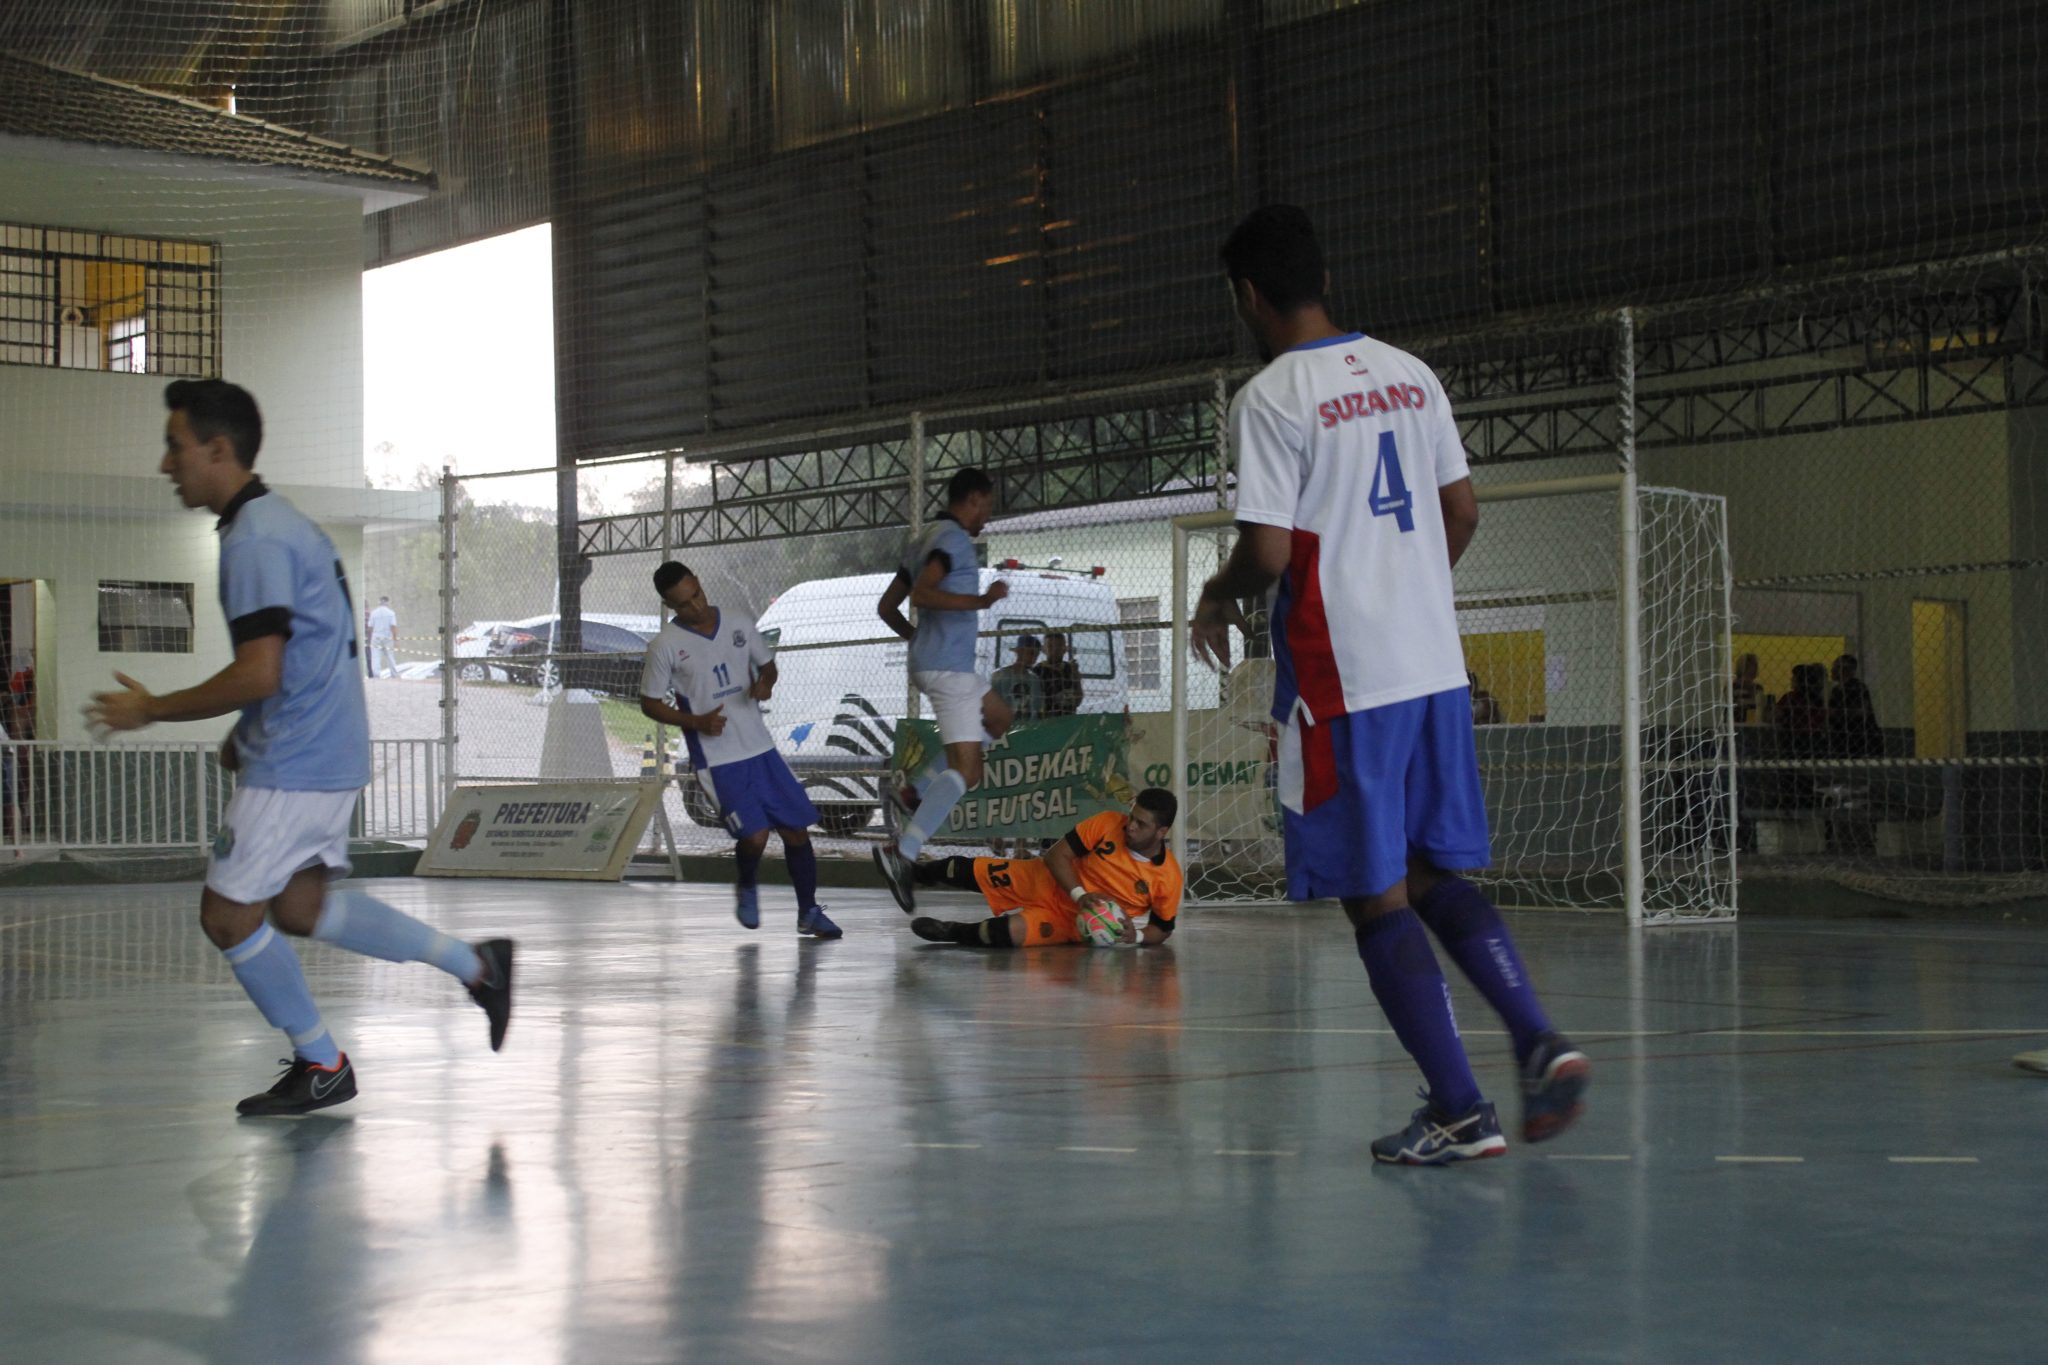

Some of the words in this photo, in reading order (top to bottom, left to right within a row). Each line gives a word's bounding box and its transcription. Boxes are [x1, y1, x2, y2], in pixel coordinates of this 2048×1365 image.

[1318, 382, 1426, 429] SUZANO
[1368, 430, 1415, 533] 4
[712, 662, 731, 688] 11
[967, 745, 1093, 793] NDEMAT
[1144, 760, 1261, 788] CODEMAT
[492, 801, 592, 825] PREFEITURA
[950, 801, 978, 832] DE
[985, 786, 1078, 828] FUTSAL
[988, 861, 1012, 888] 12
